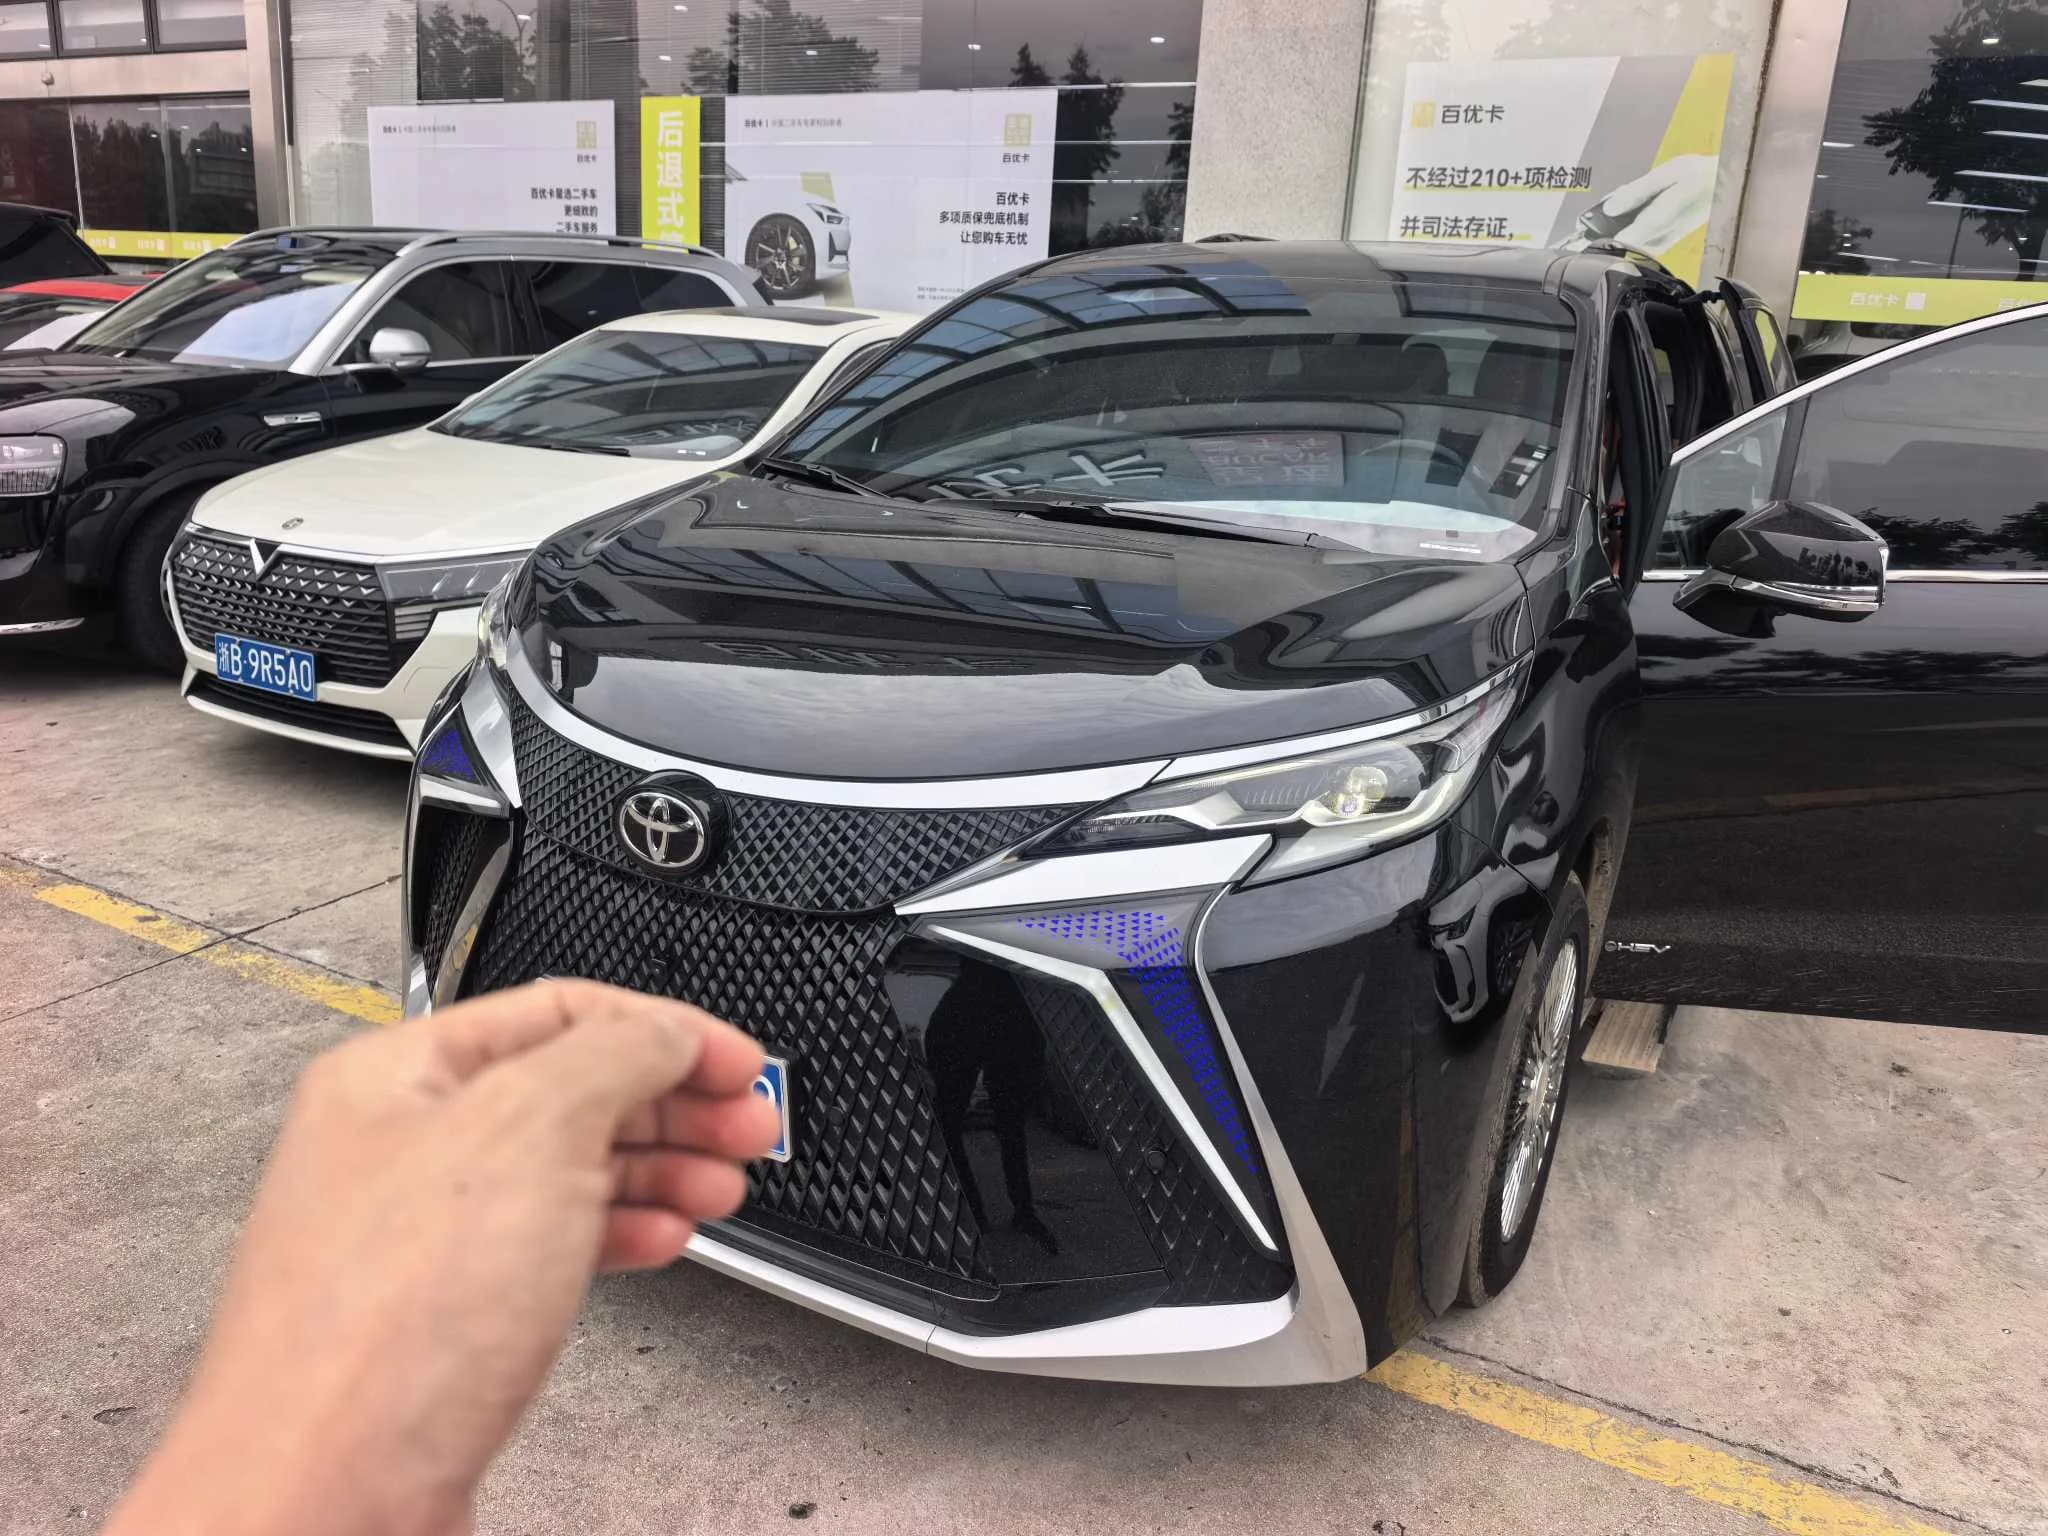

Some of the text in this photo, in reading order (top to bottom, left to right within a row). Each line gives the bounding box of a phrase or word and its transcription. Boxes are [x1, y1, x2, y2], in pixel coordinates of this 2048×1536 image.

[1440, 104, 1505, 124] 百优卡
[1002, 152, 1031, 163] 百优卡
[1406, 166, 1592, 190] 不经过210+项检测
[996, 191, 1030, 205] 百优卡
[939, 211, 1029, 225] 多项质保兜底机制
[960, 231, 1027, 245] 让您购车无忧
